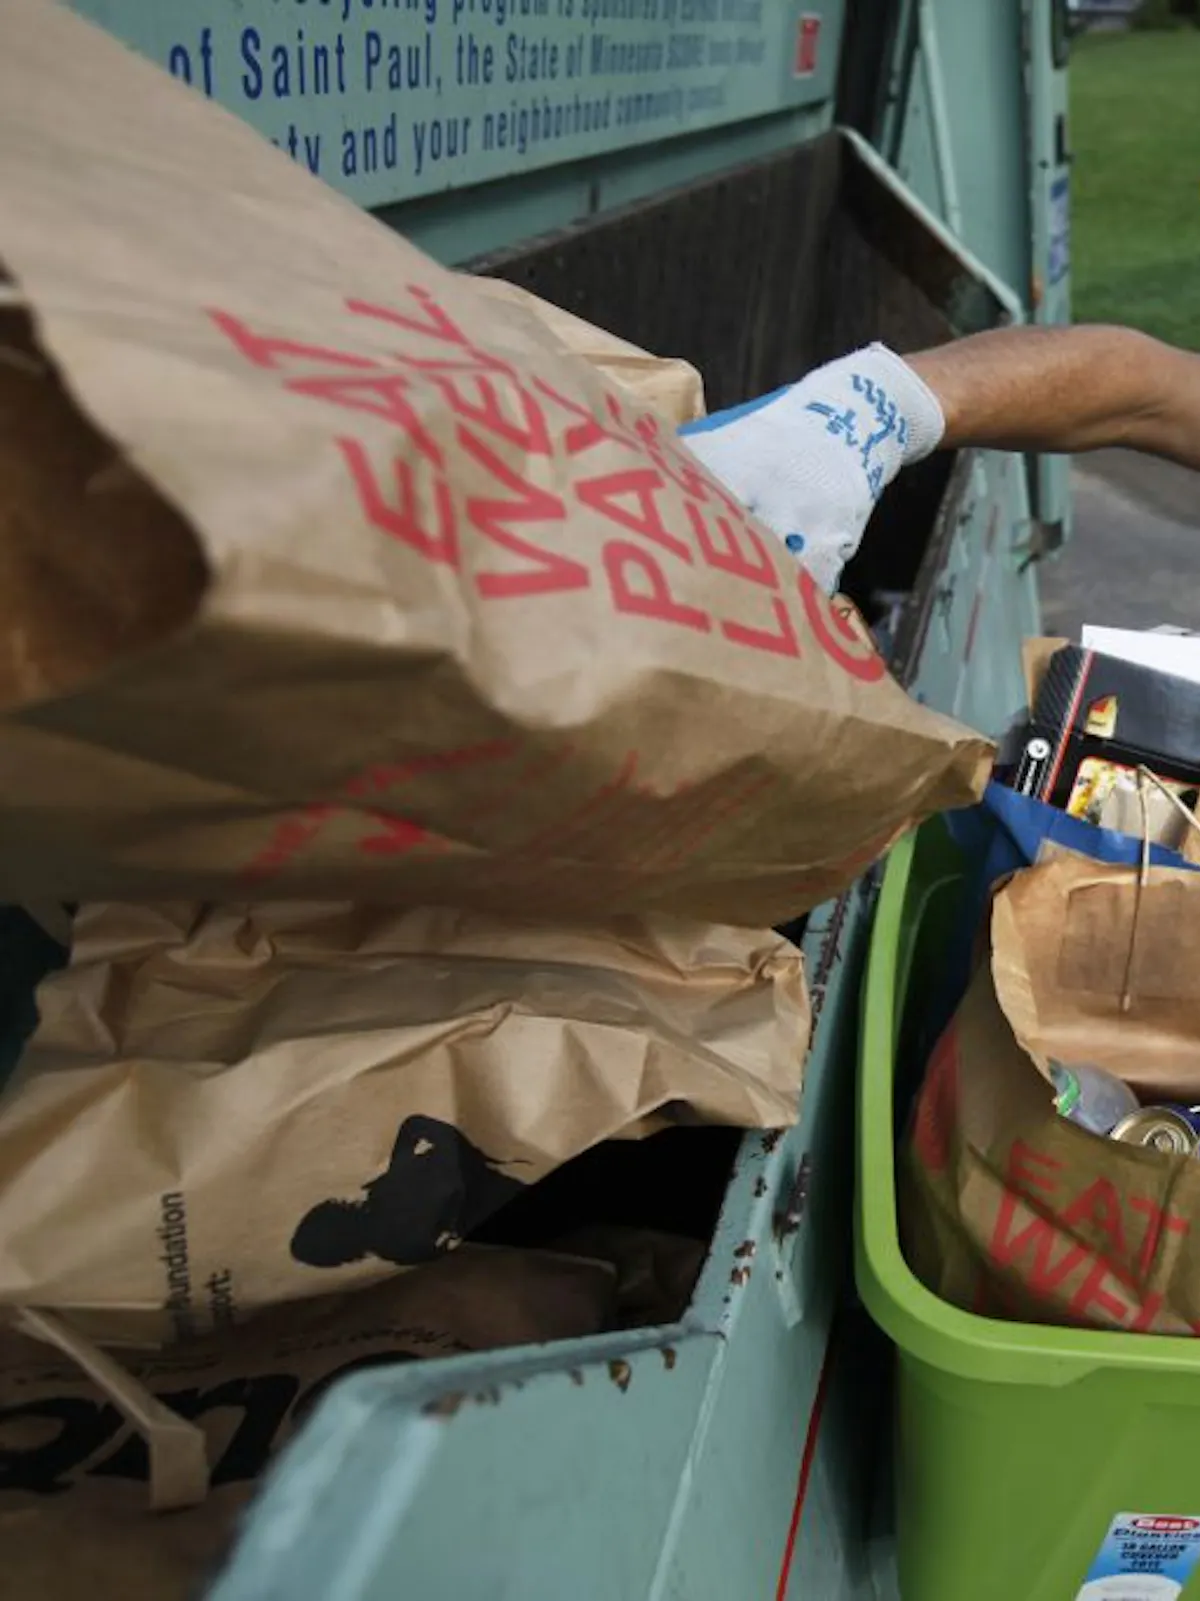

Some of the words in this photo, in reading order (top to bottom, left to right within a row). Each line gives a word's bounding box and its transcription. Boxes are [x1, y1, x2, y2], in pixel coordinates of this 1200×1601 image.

[168, 27, 212, 98] of
[240, 26, 346, 100] Saint
[365, 31, 442, 95] Paul,
[457, 33, 494, 85] the
[506, 32, 559, 83] State
[566, 33, 583, 78] of
[342, 112, 398, 176] and
[412, 116, 471, 175] your
[204, 306, 462, 575] EAT
[1005, 1137, 1191, 1285] EAT
